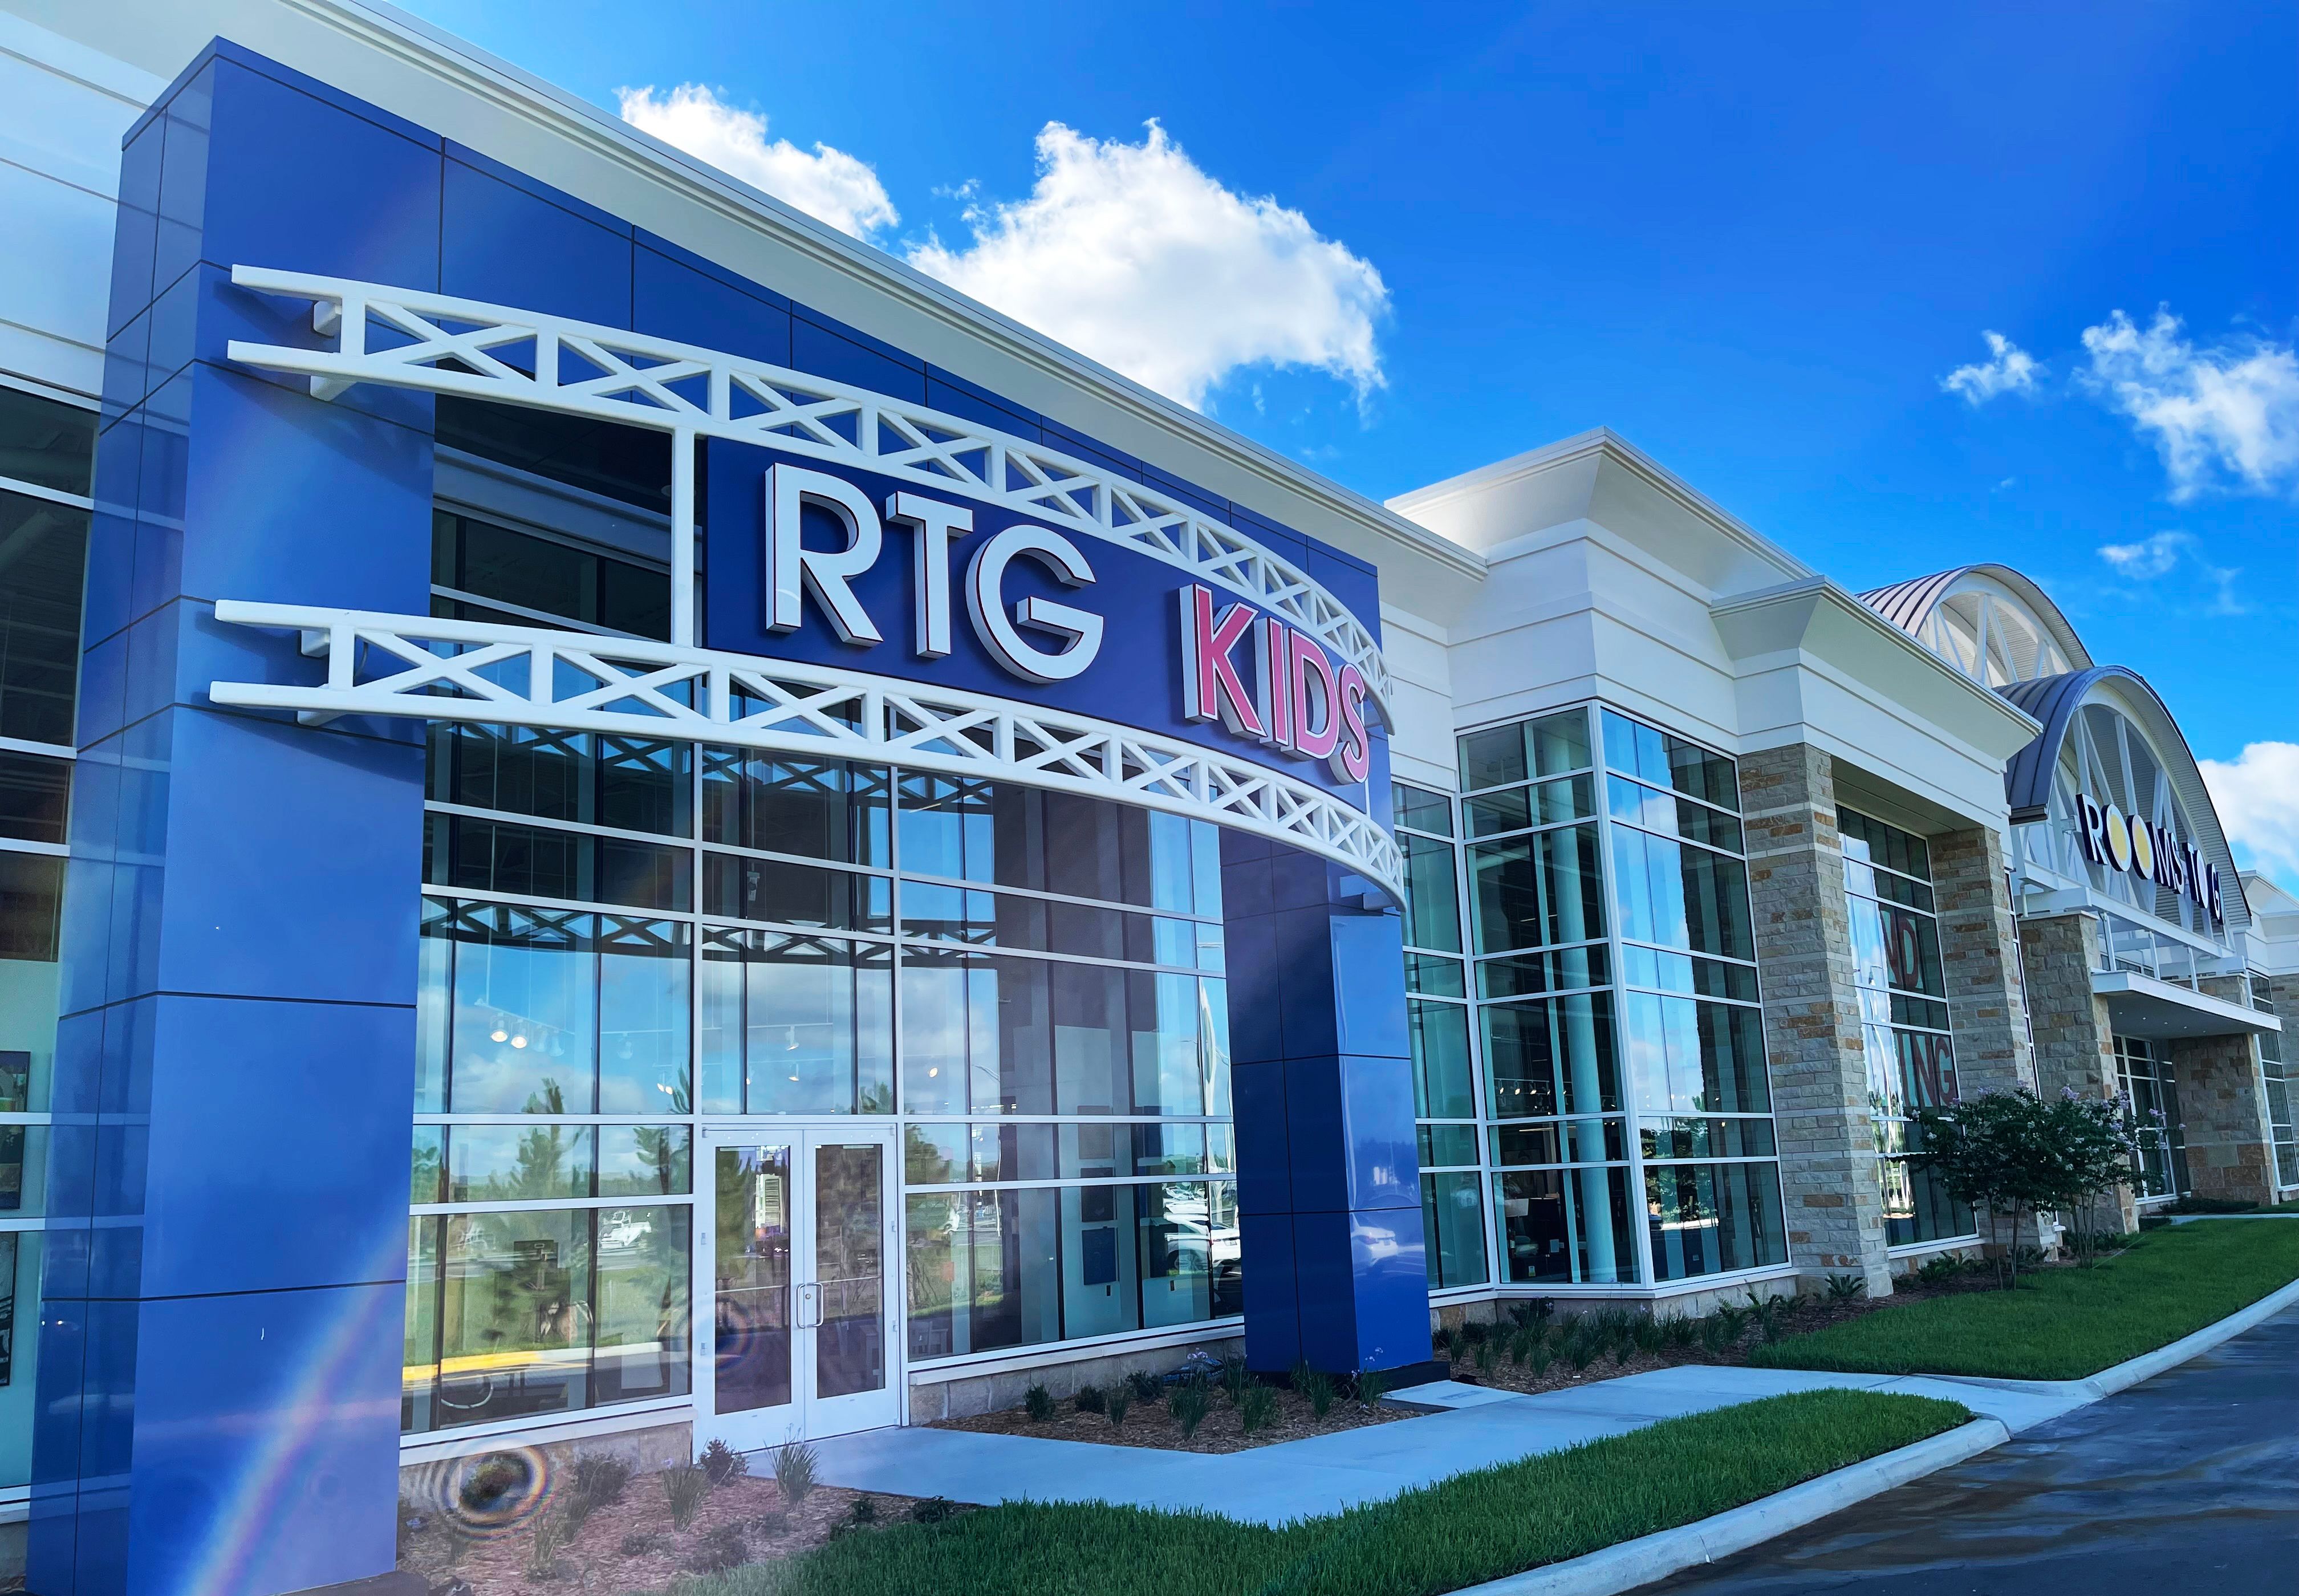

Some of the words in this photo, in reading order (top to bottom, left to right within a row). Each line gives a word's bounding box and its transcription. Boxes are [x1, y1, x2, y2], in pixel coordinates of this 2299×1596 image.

[765, 462, 1104, 684] RTG
[1179, 582, 1370, 785] KIDS
[2075, 793, 2185, 895] ROOMS
[2182, 842, 2208, 909] TO
[2205, 863, 2224, 925] G
